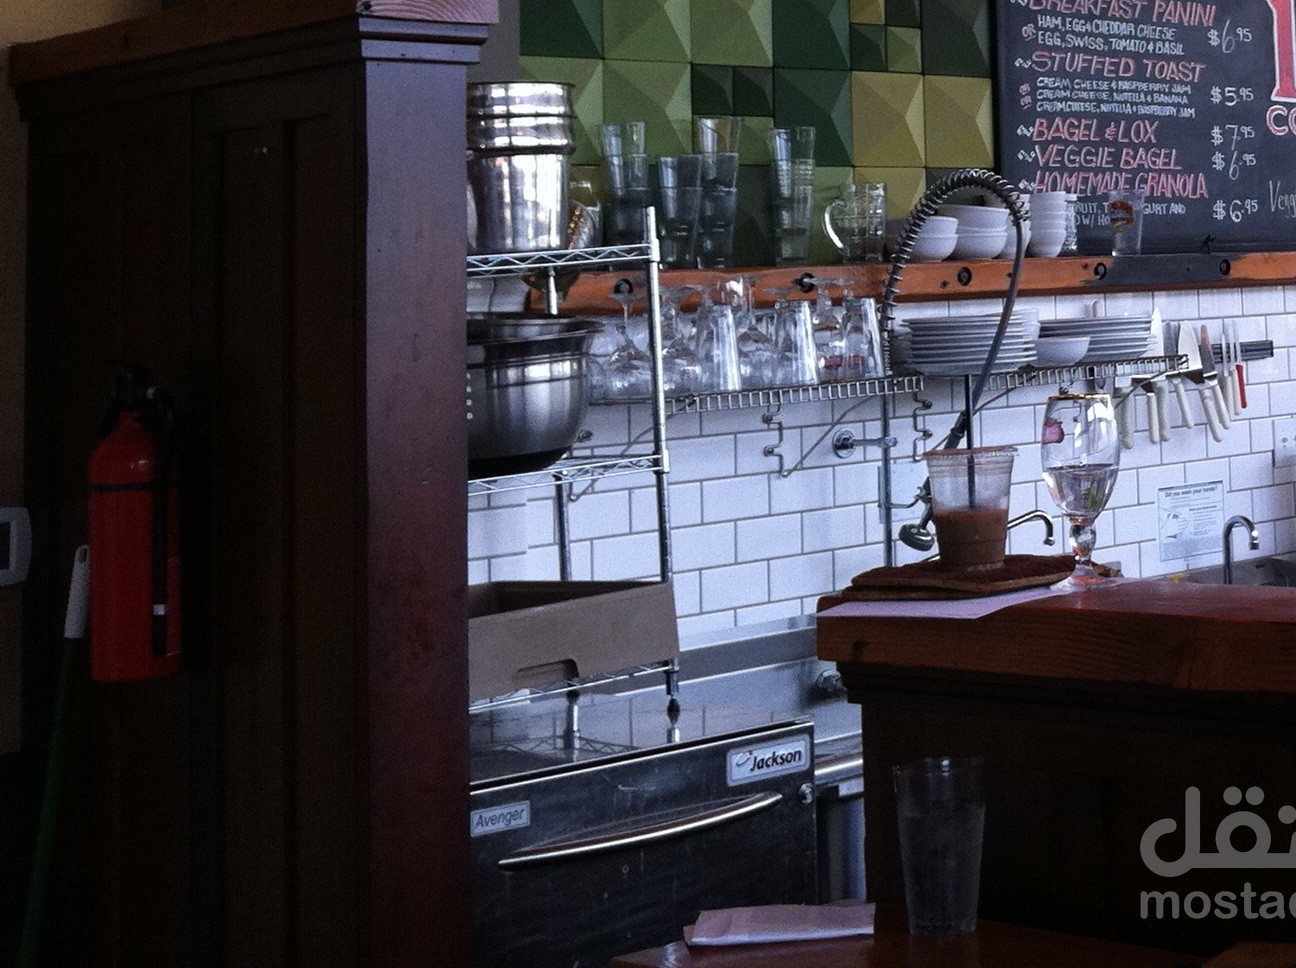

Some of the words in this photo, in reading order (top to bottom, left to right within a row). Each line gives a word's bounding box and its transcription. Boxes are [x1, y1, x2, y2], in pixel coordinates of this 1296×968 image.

[1152, 0, 1217, 27] PANINI
[1021, 24, 1037, 41] OR
[1066, 17, 1085, 32] EGG
[1092, 20, 1135, 36] CHEDDAR
[1137, 24, 1178, 40] CHEESE
[1109, 38, 1147, 53] TOMATO
[1155, 41, 1185, 55] BASIL
[1031, 51, 1135, 78] STUFFED
[1143, 59, 1206, 82] TOAST
[1036, 77, 1071, 89] CREAM
[1073, 79, 1110, 91] CHEESE
[1036, 89, 1071, 100] CREAM
[1152, 94, 1189, 105] BANANA
[1032, 117, 1100, 141] BAGEL
[1118, 119, 1160, 144] LOX
[1034, 144, 1116, 168] VEGGIE
[1120, 147, 1182, 170] BAGEL
[1033, 170, 1132, 198] HOMEMADE
[1135, 172, 1209, 198] GRANOLA
[1168, 202, 1187, 214] AND
[749, 747, 803, 773] Jackson
[475, 806, 526, 830] Avenger
